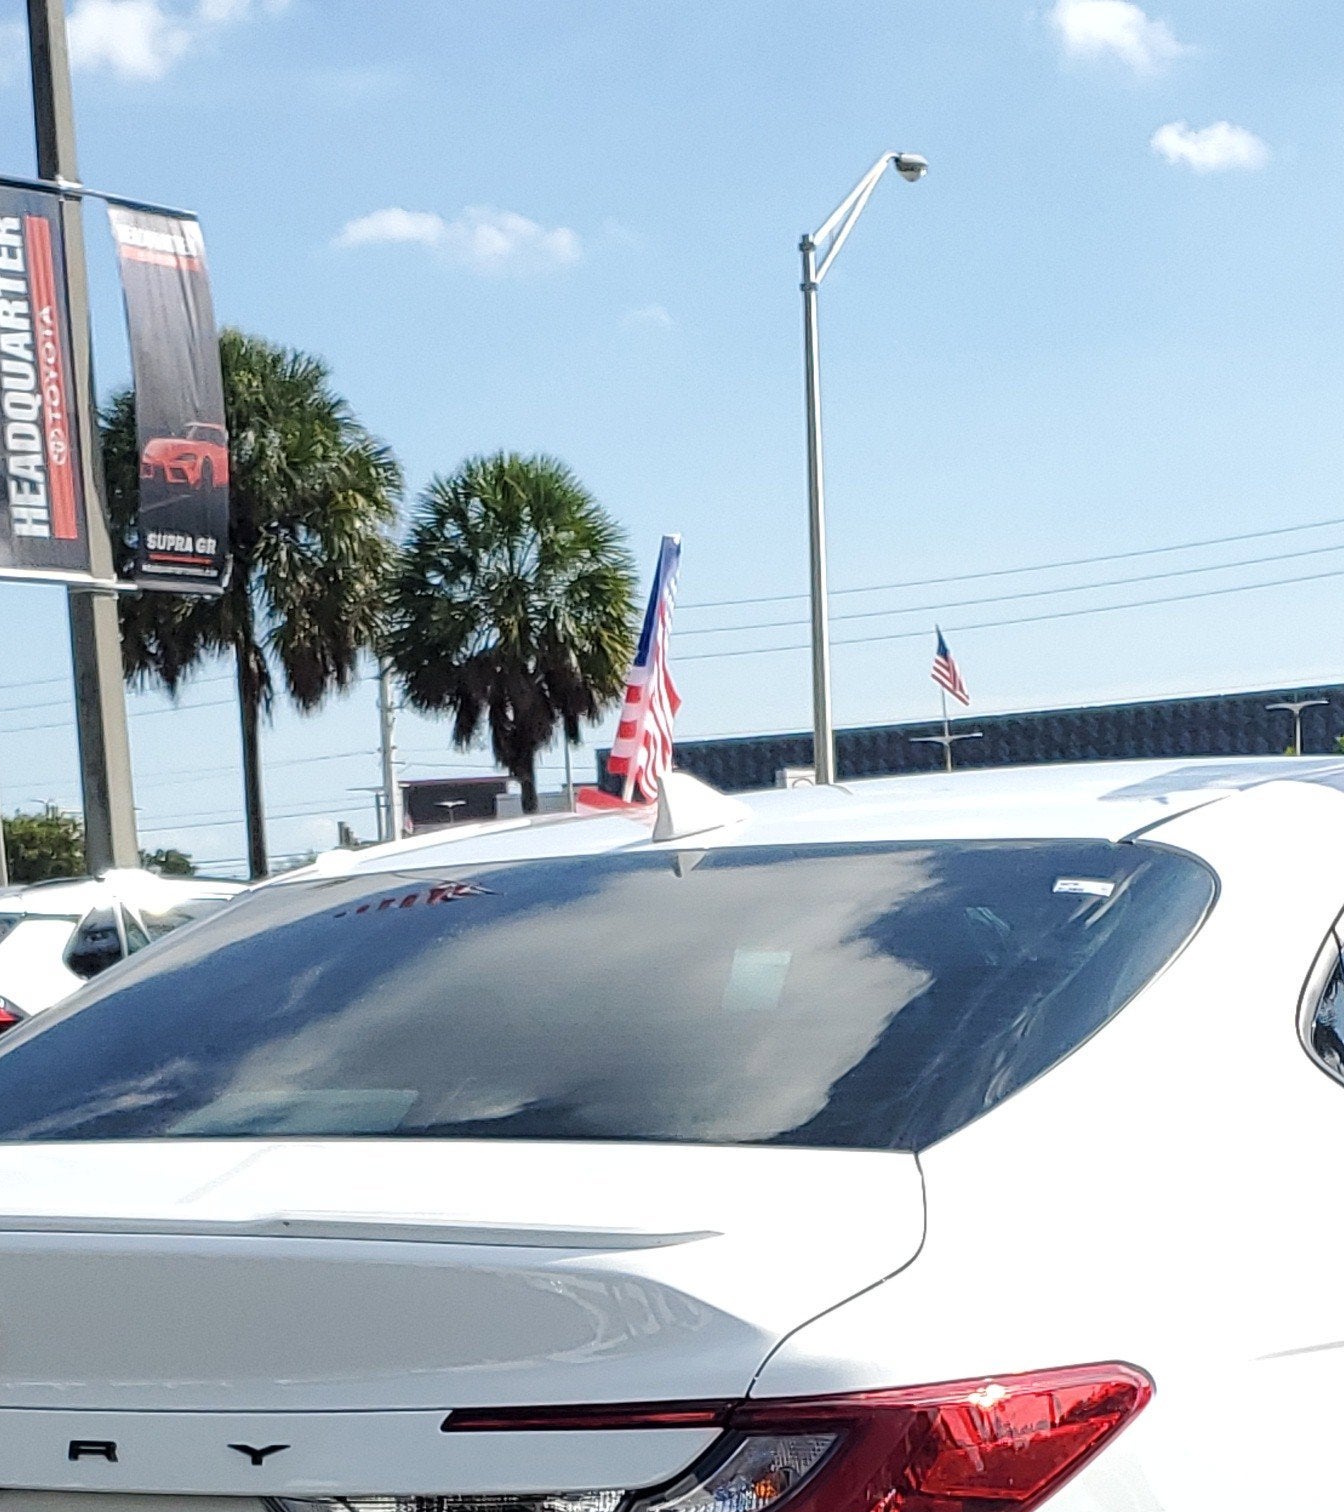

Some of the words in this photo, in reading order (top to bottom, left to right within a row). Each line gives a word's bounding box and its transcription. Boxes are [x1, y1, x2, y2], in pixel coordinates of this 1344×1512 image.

[37, 305, 66, 423] TOYOTA
[146, 532, 193, 553] SUPRA
[195, 537, 217, 555] GR
